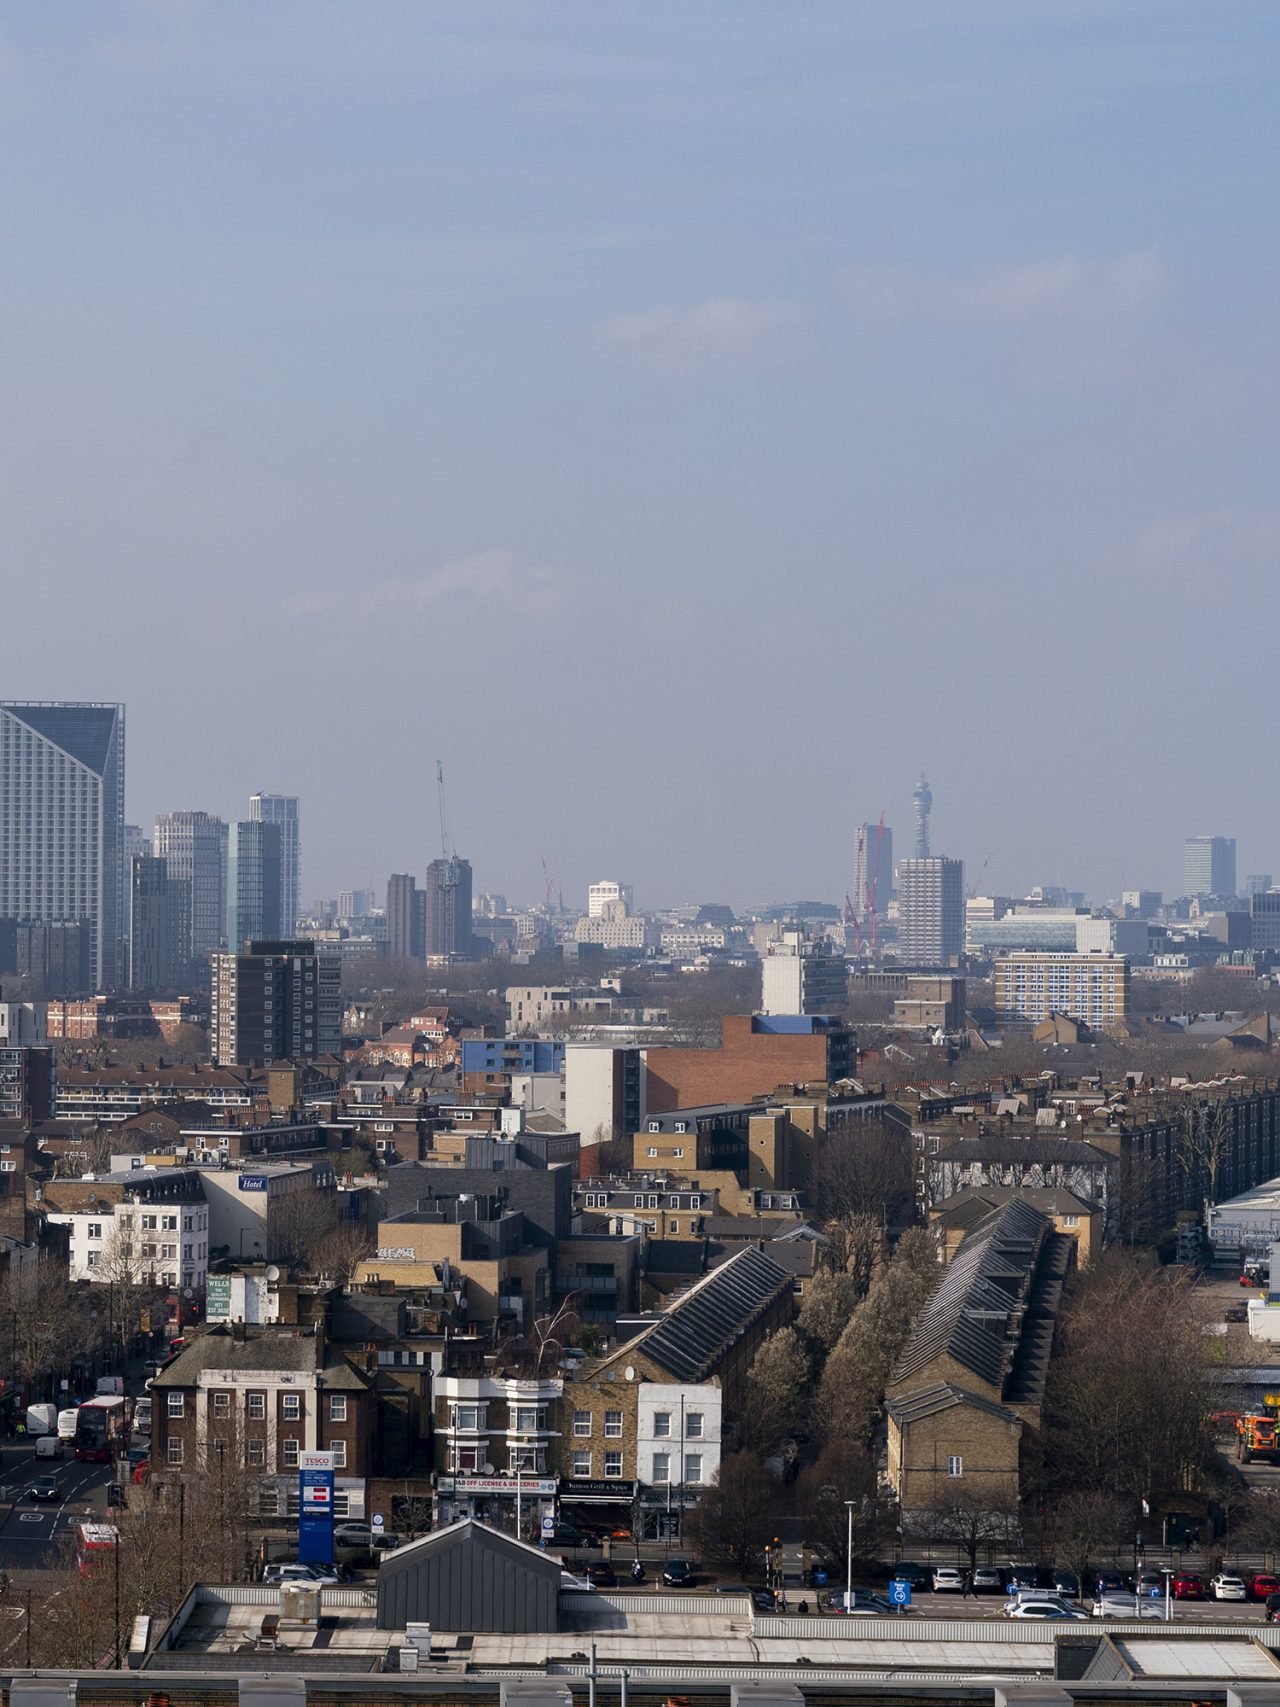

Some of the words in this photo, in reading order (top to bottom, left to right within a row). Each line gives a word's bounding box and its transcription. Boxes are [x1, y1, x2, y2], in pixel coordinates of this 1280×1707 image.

[243, 1180, 263, 1188] Hotel
[590, 1482, 606, 1490] Grill
[611, 1484, 629, 1492] Spice
